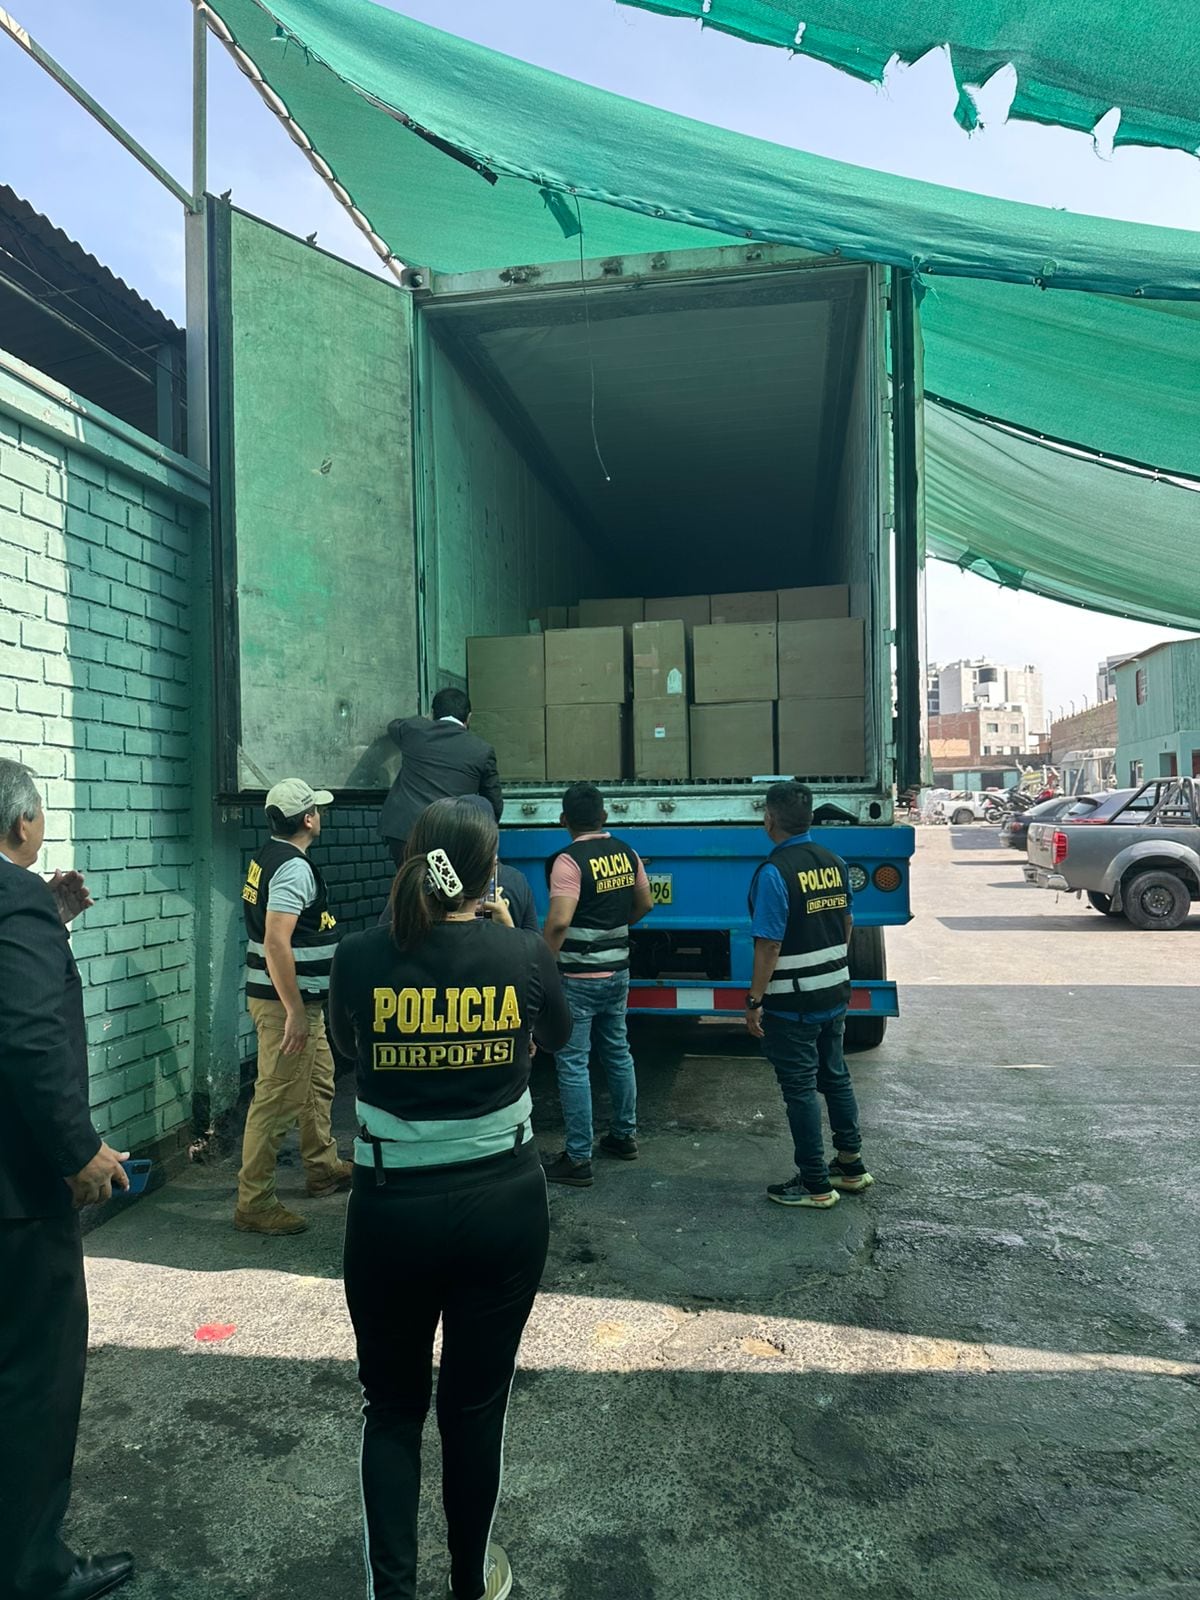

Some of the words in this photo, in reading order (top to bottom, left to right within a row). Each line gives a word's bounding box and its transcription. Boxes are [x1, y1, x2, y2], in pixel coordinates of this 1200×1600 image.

[589, 853, 633, 880] POLICIA
[798, 866, 843, 893] POLICIA
[598, 875, 635, 891] DIRPOFIS
[373, 985, 522, 1034] POLICIA
[378, 1041, 510, 1067] DIRPOFIS
